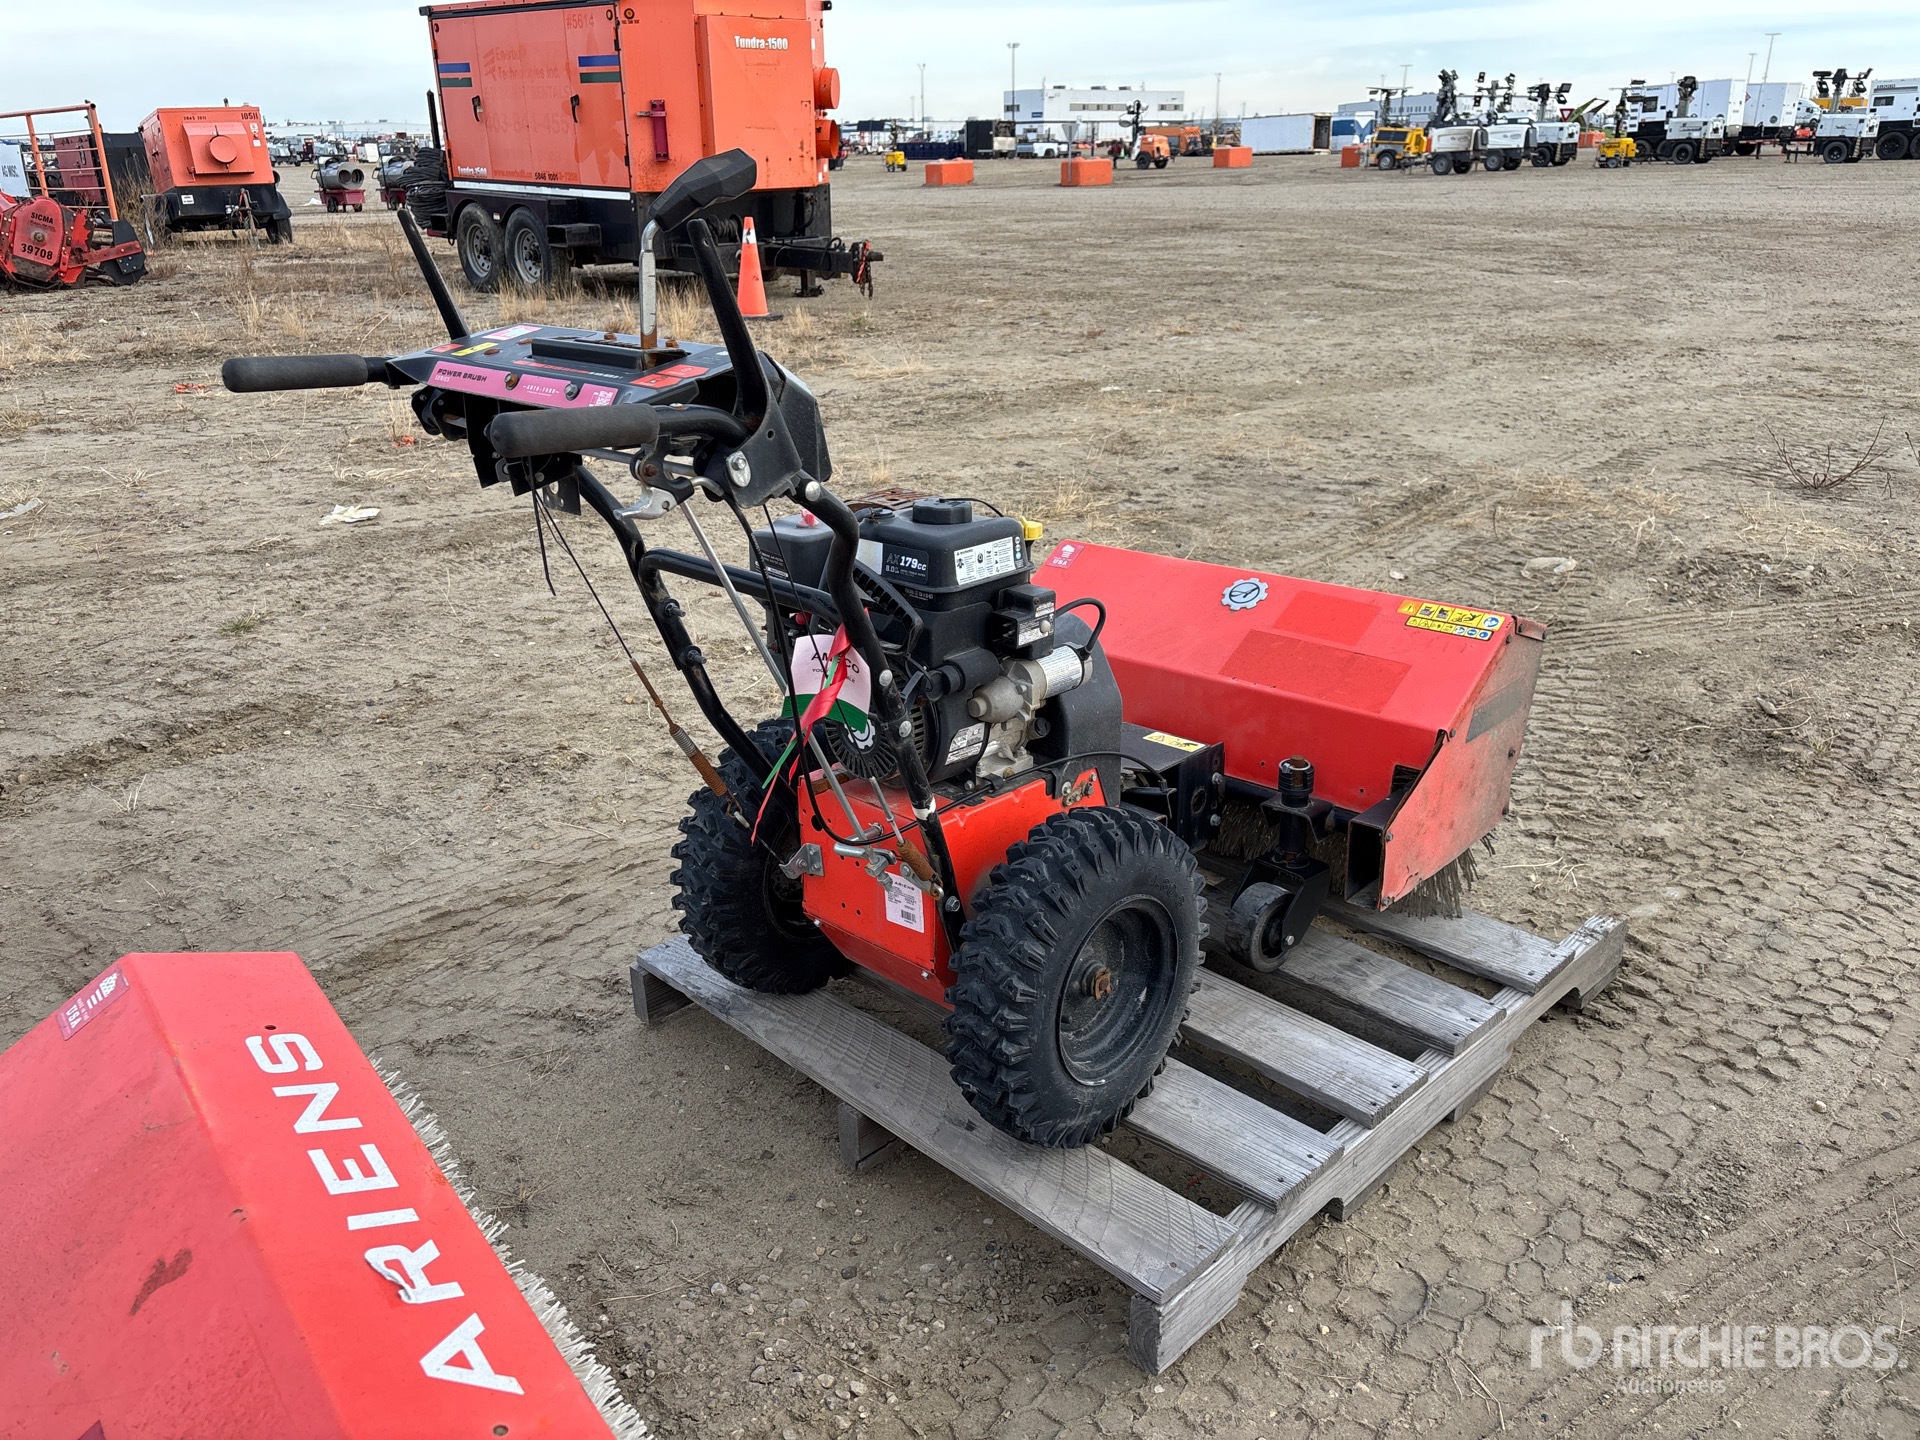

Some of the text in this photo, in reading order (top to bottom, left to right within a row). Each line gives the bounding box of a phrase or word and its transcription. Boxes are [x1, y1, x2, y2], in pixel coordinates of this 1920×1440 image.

[734, 35, 789, 51] Tundra-1500
[241, 112, 258, 120] 10511
[31, 212, 54, 225] SICMA
[21, 243, 54, 260] 39708
[434, 374, 451, 383] SERIES
[437, 368, 488, 383] POWER BRUSH
[887, 552, 900, 565] AX
[900, 555, 927, 571] 179cc
[1052, 558, 1068, 566] USA
[894, 881, 915, 891] ARIENS
[66, 1004, 83, 1029] USA
[247, 1032, 525, 1397] ARIENS
